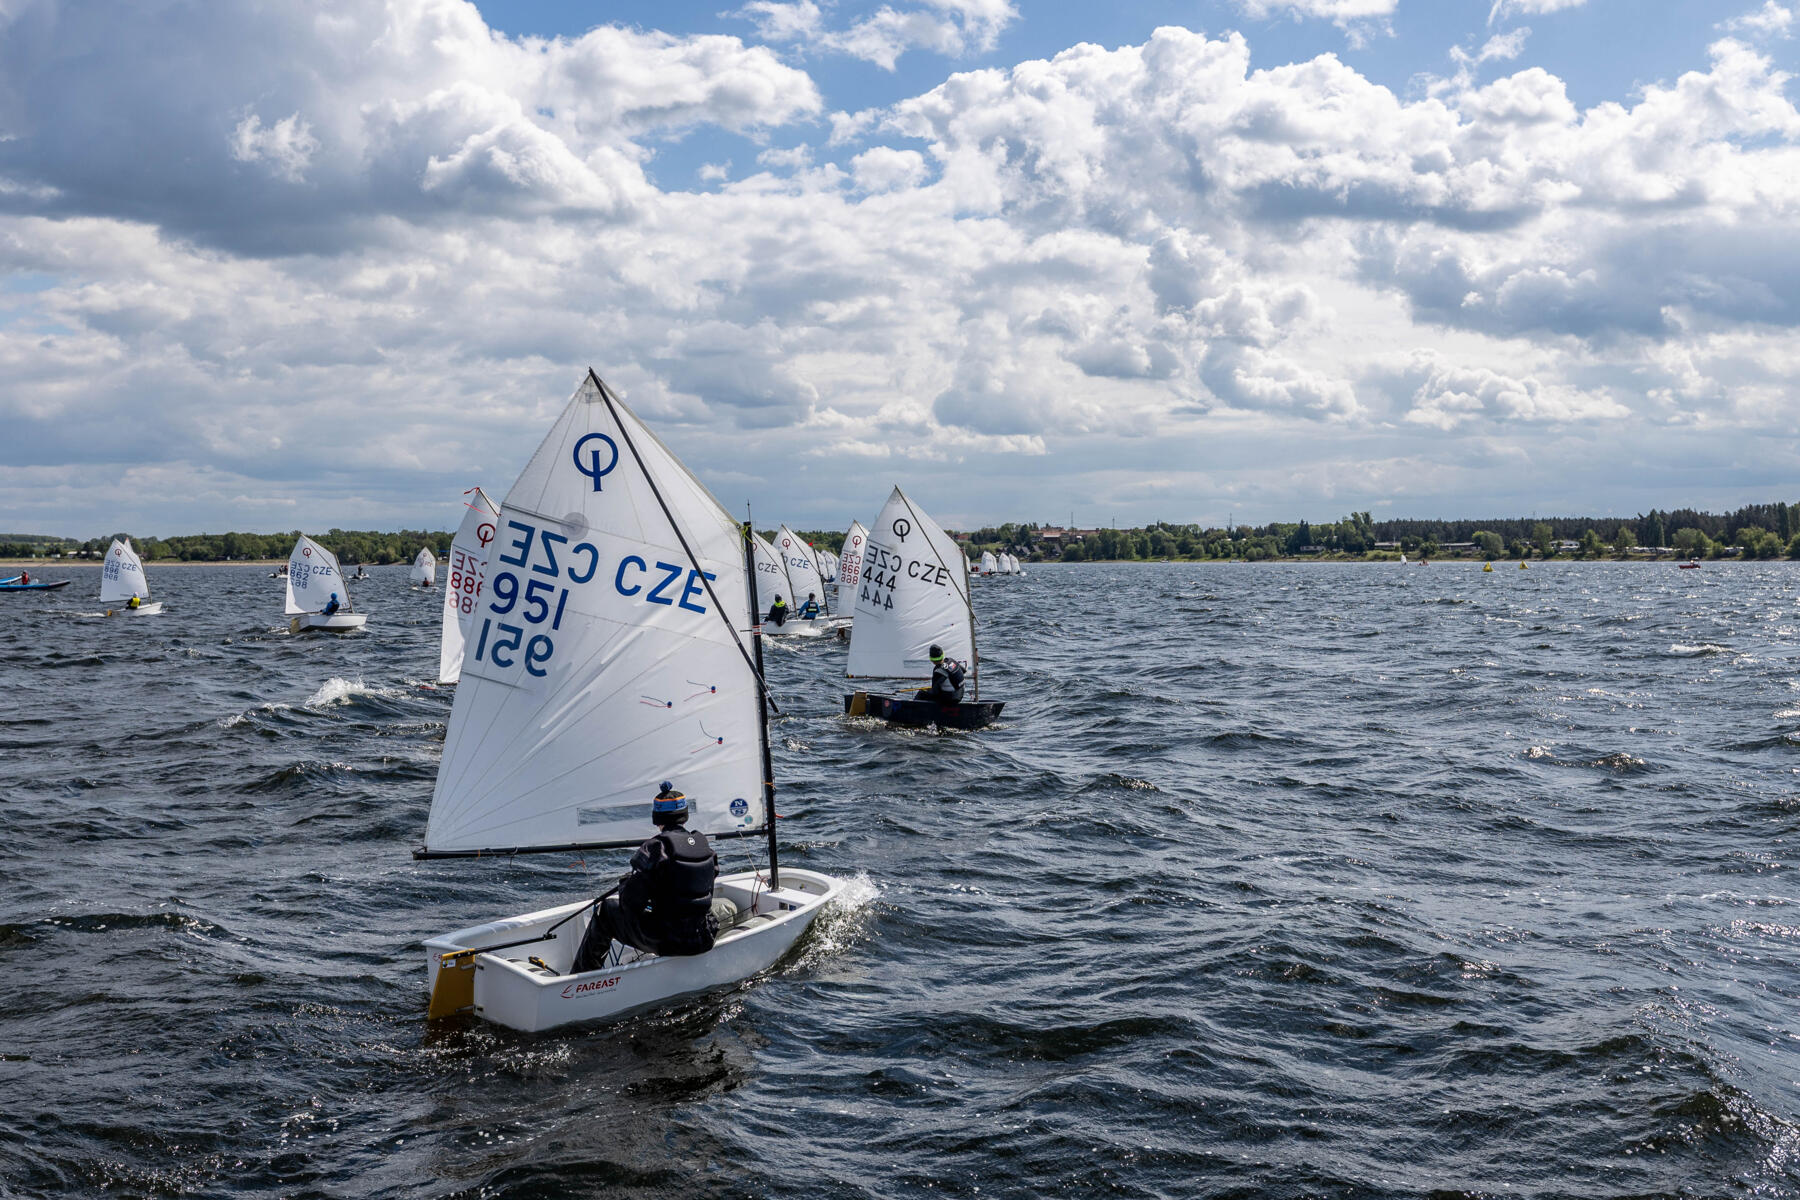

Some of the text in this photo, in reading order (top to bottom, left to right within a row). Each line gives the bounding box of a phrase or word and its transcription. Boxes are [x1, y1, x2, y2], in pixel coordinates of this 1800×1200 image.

[121, 562, 137, 571] CZE
[757, 562, 778, 574] CZE
[790, 557, 810, 569] CZE
[290, 569, 309, 581] 862
[312, 565, 333, 576] CZE
[908, 560, 950, 586] CZE
[615, 555, 717, 615] CZE
[862, 566, 896, 592] 444
[489, 572, 569, 630] 951
[575, 976, 622, 993] FAREAST
